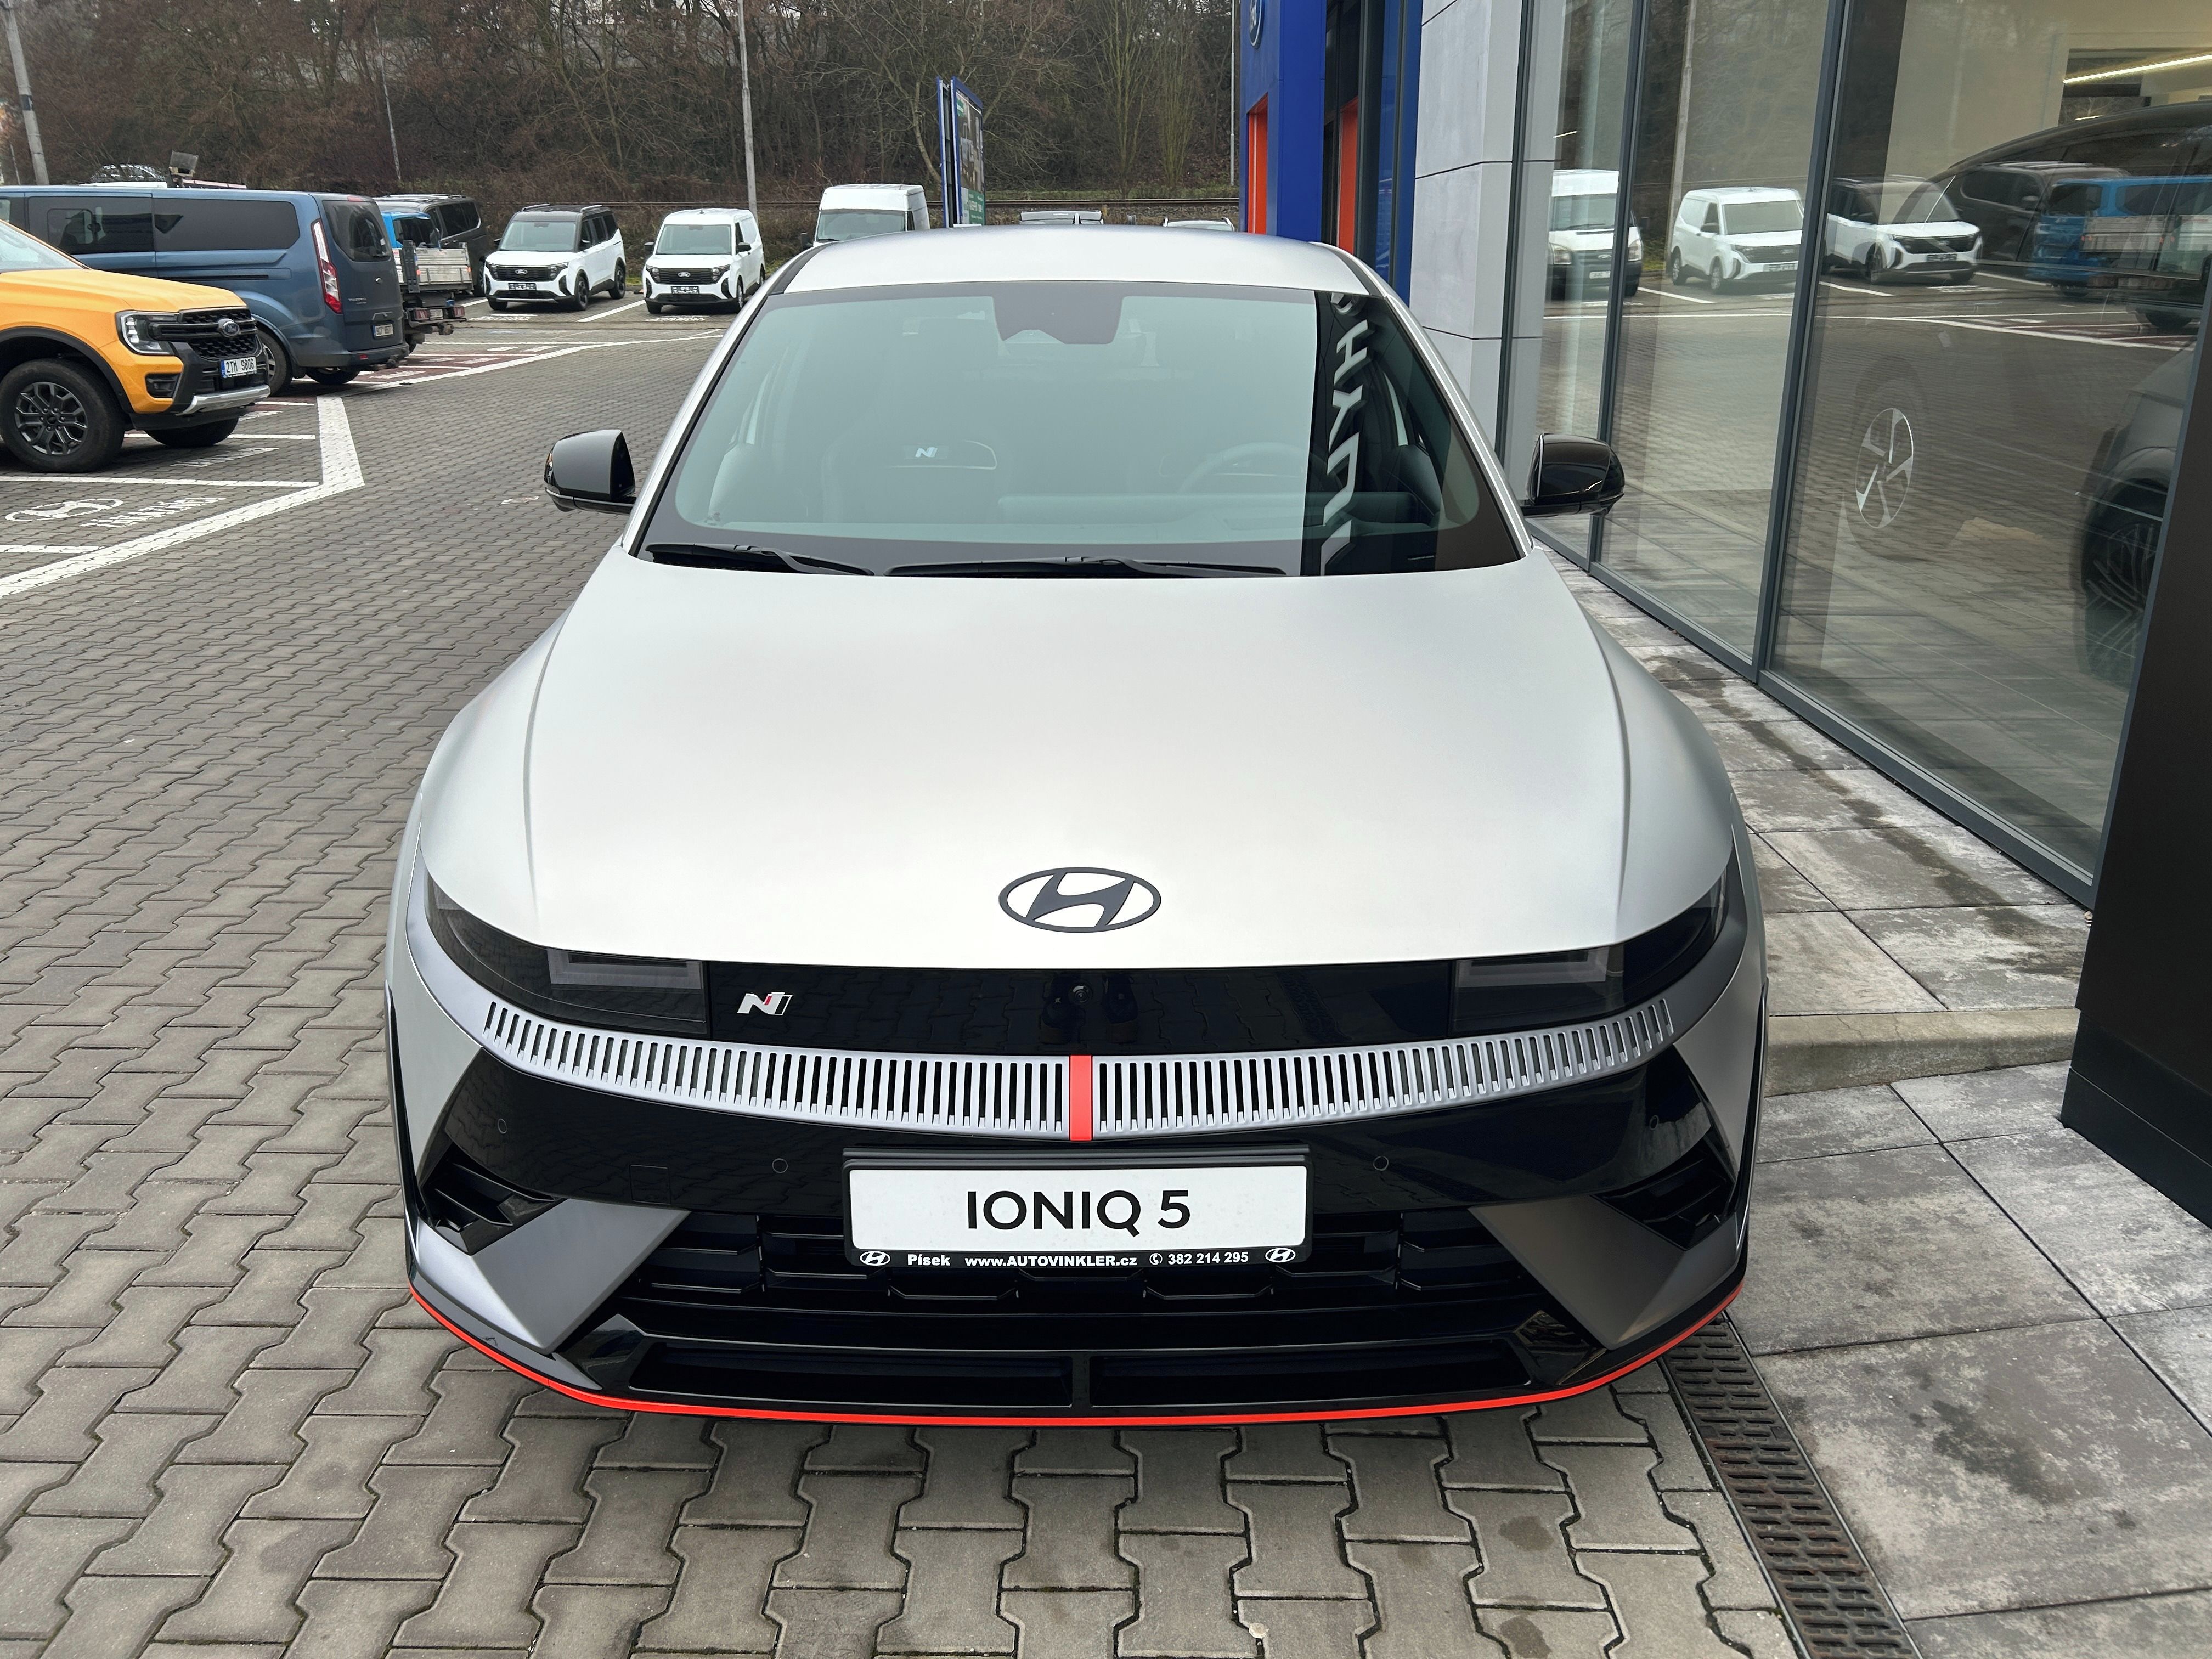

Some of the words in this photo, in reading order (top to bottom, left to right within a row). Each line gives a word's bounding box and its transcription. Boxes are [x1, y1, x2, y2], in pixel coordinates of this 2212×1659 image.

[967, 1190, 1141, 1238] IONIQ
[1157, 1189, 1190, 1229] 5
[907, 1254, 951, 1266] Písek
[964, 1255, 1137, 1267] www.AUTOVINKLER.cz
[1167, 1253, 1192, 1265] 382
[1196, 1252, 1221, 1264] 214
[1224, 1251, 1249, 1263] 295
